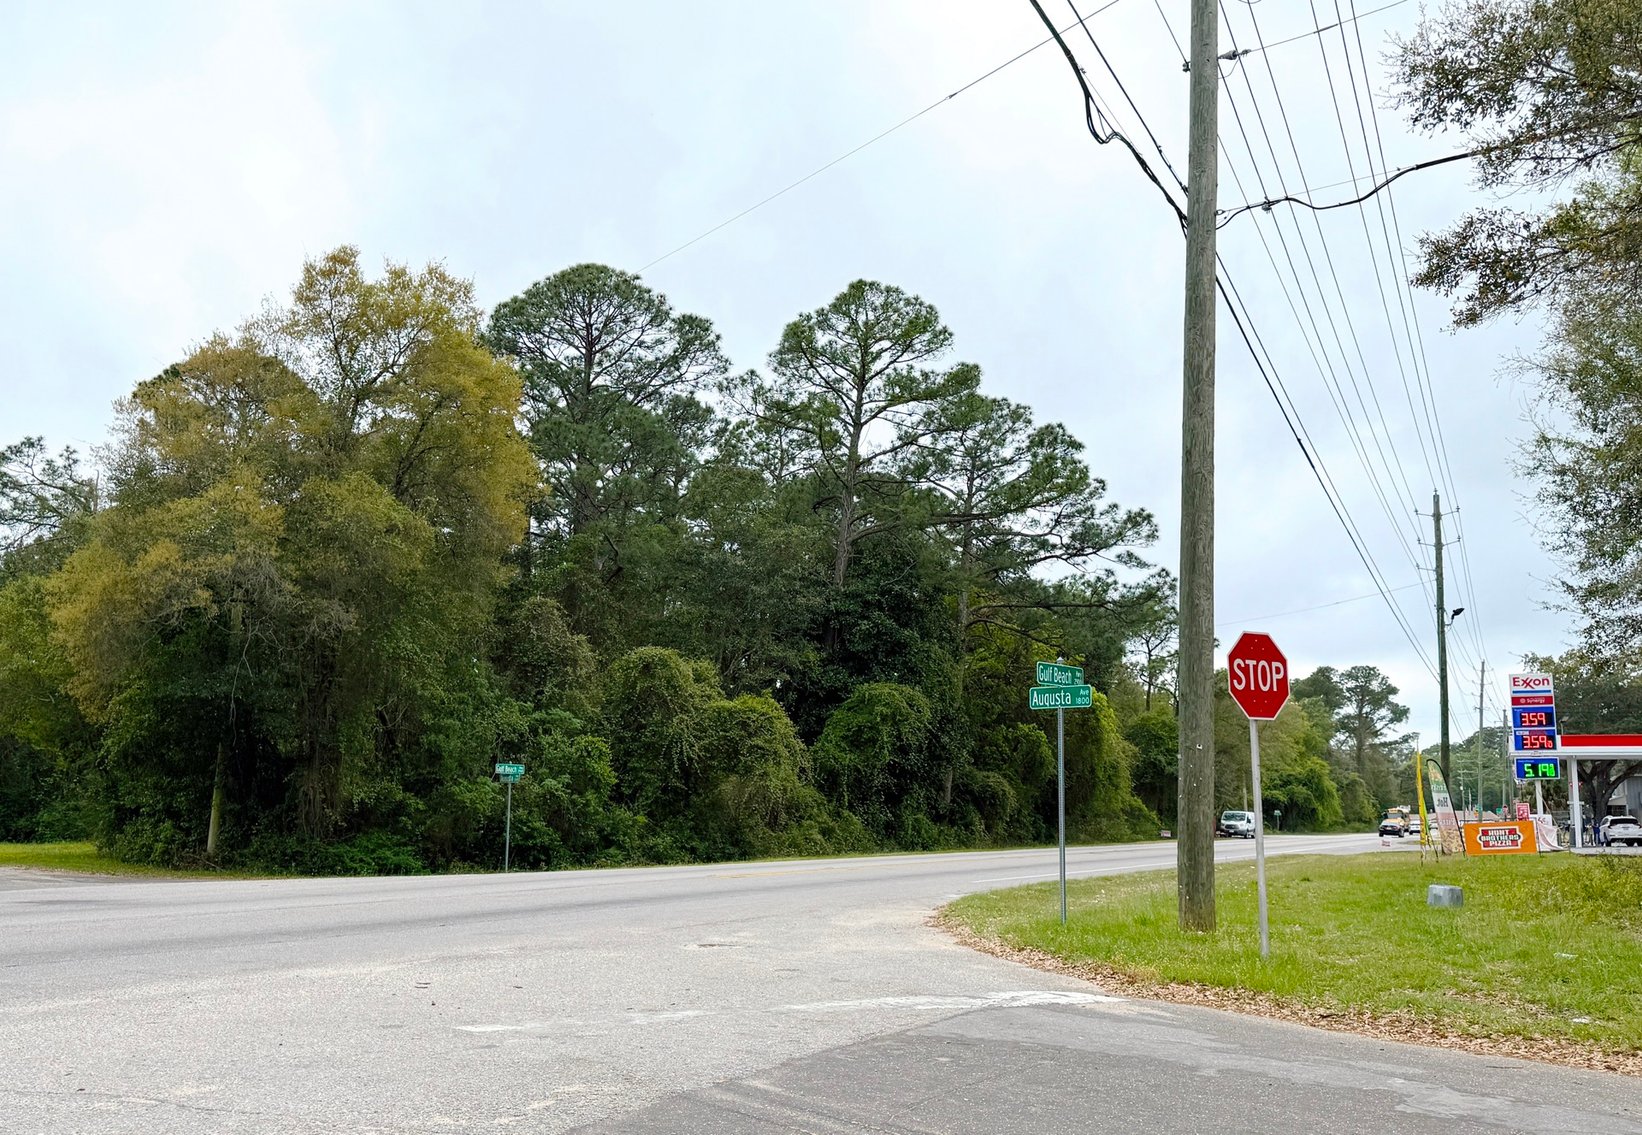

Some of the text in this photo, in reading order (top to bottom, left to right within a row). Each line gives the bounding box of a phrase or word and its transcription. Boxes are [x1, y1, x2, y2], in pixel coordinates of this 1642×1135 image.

[1038, 665, 1072, 684] Gulf Beach
[1232, 658, 1284, 692] STOP
[1512, 676, 1550, 690] Exxon
[1032, 690, 1071, 707] Augusta
[1079, 688, 1089, 696] Ave
[1075, 696, 1090, 705] 1800
